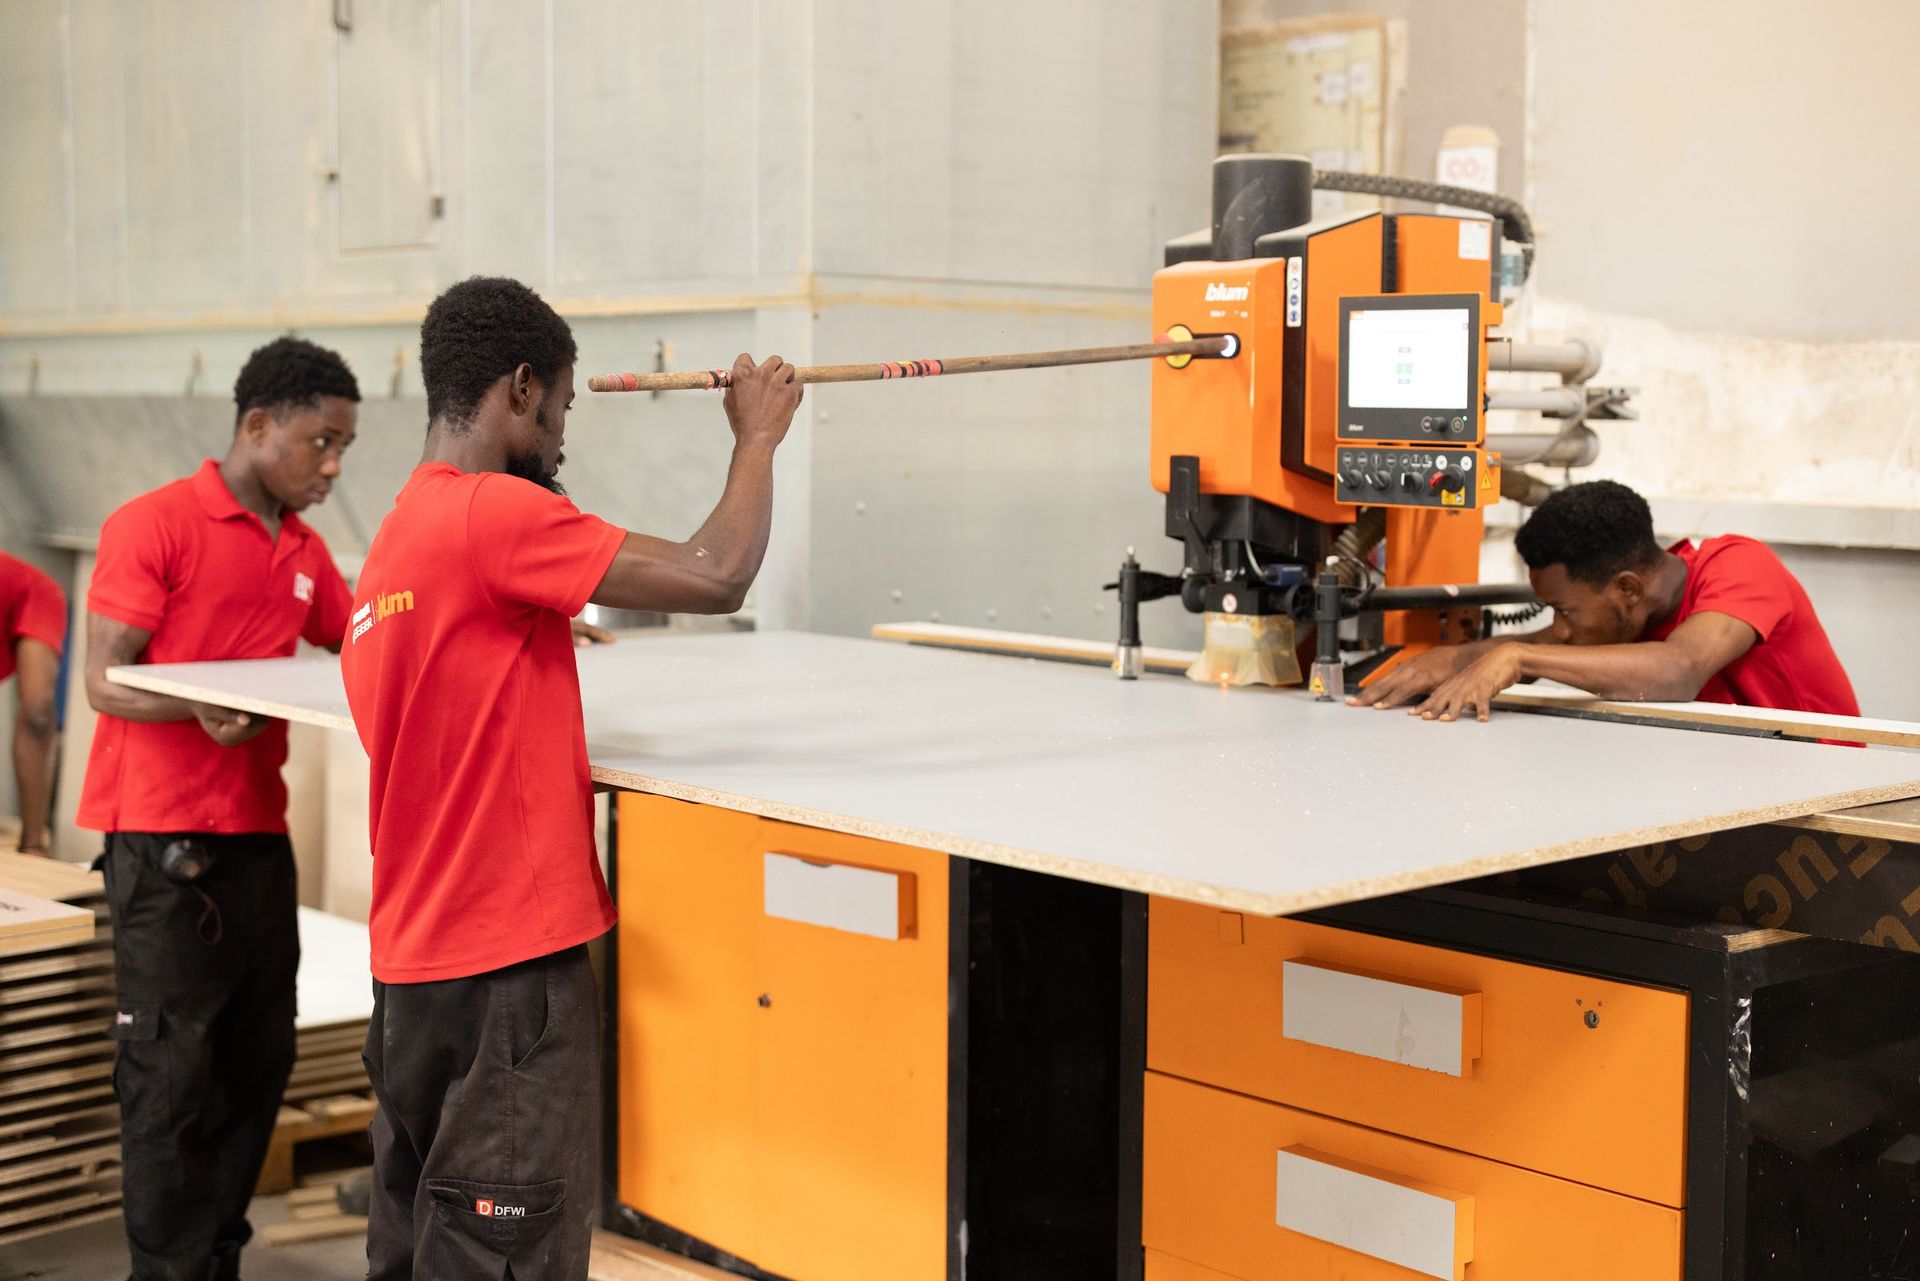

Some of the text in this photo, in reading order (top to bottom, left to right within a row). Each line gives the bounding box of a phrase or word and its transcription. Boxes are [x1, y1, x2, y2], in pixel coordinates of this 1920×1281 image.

[1205, 282, 1249, 302] blum
[480, 1201, 525, 1216] D DFWI
